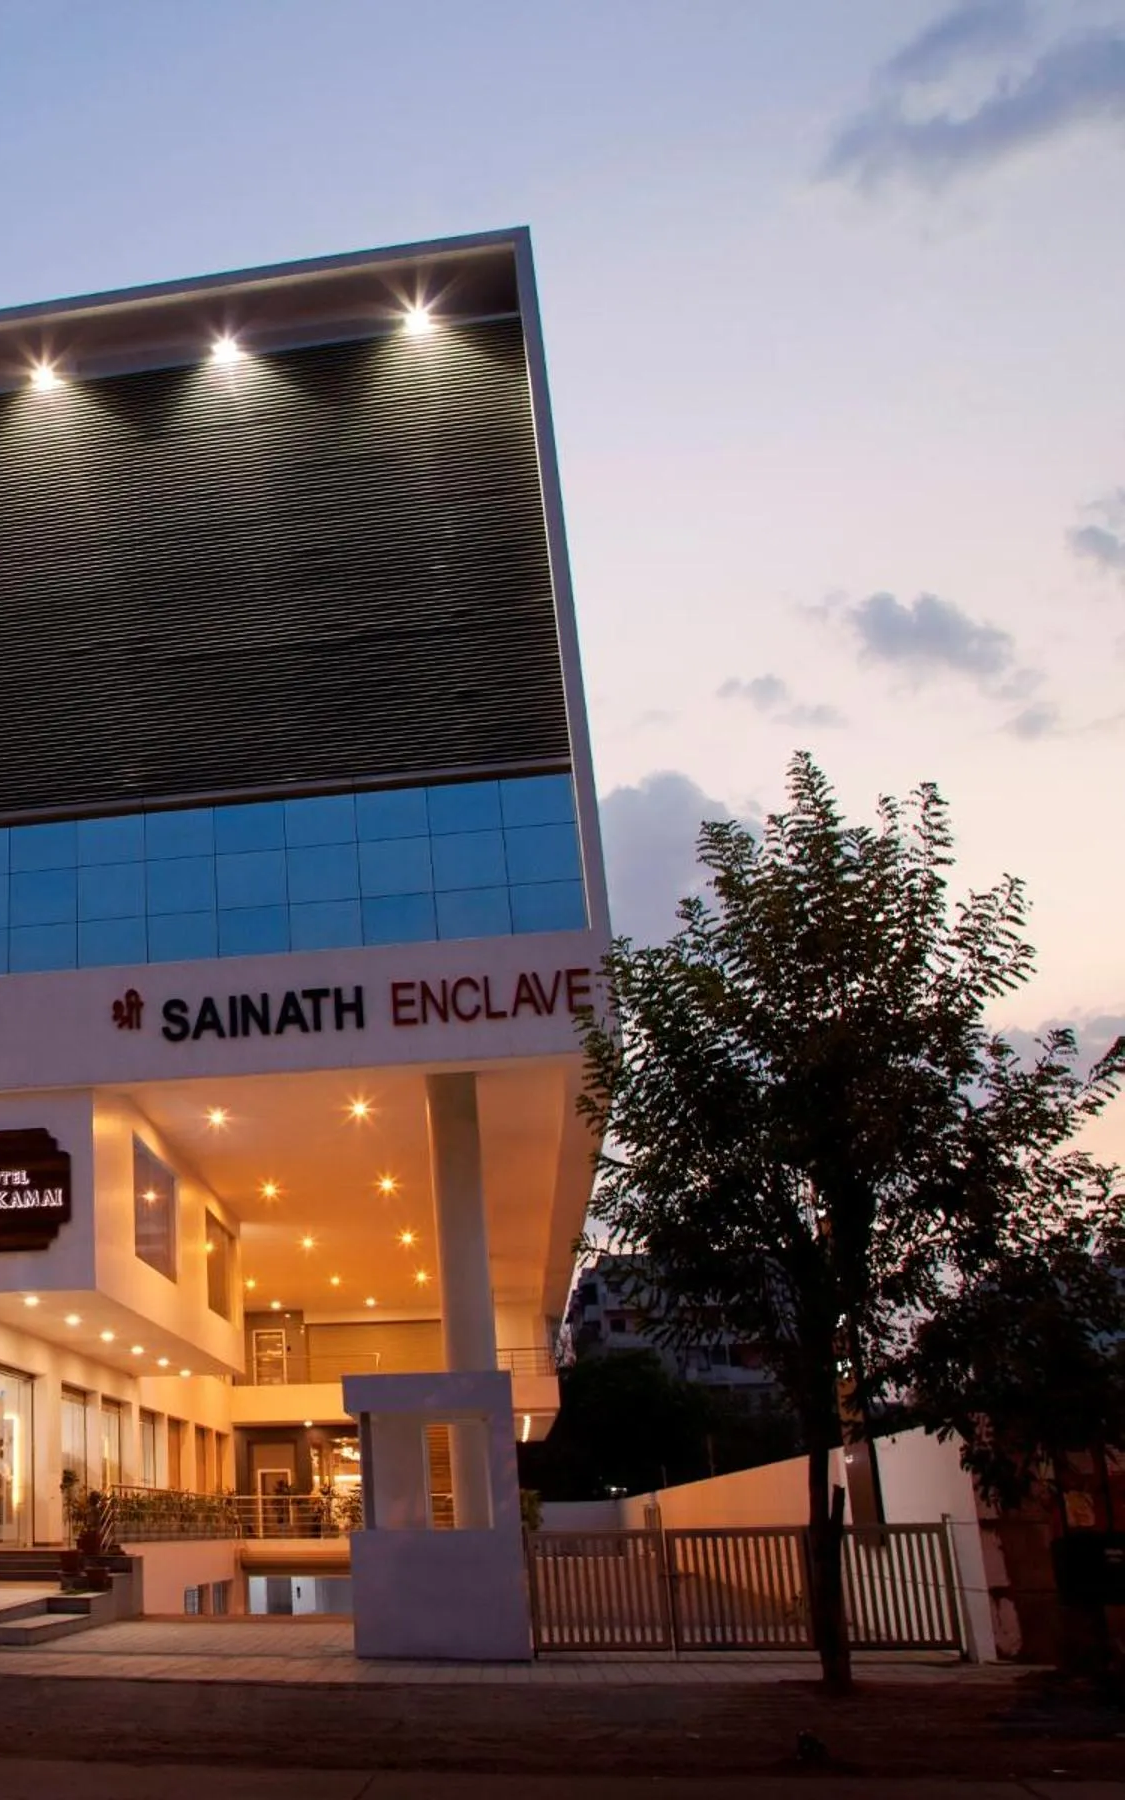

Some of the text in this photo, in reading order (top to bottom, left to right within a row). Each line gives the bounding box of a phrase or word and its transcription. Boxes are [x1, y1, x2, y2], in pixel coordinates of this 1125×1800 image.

[112, 988, 144, 1030] श्री
[161, 968, 594, 1042] SAINATH ENCLAVE
